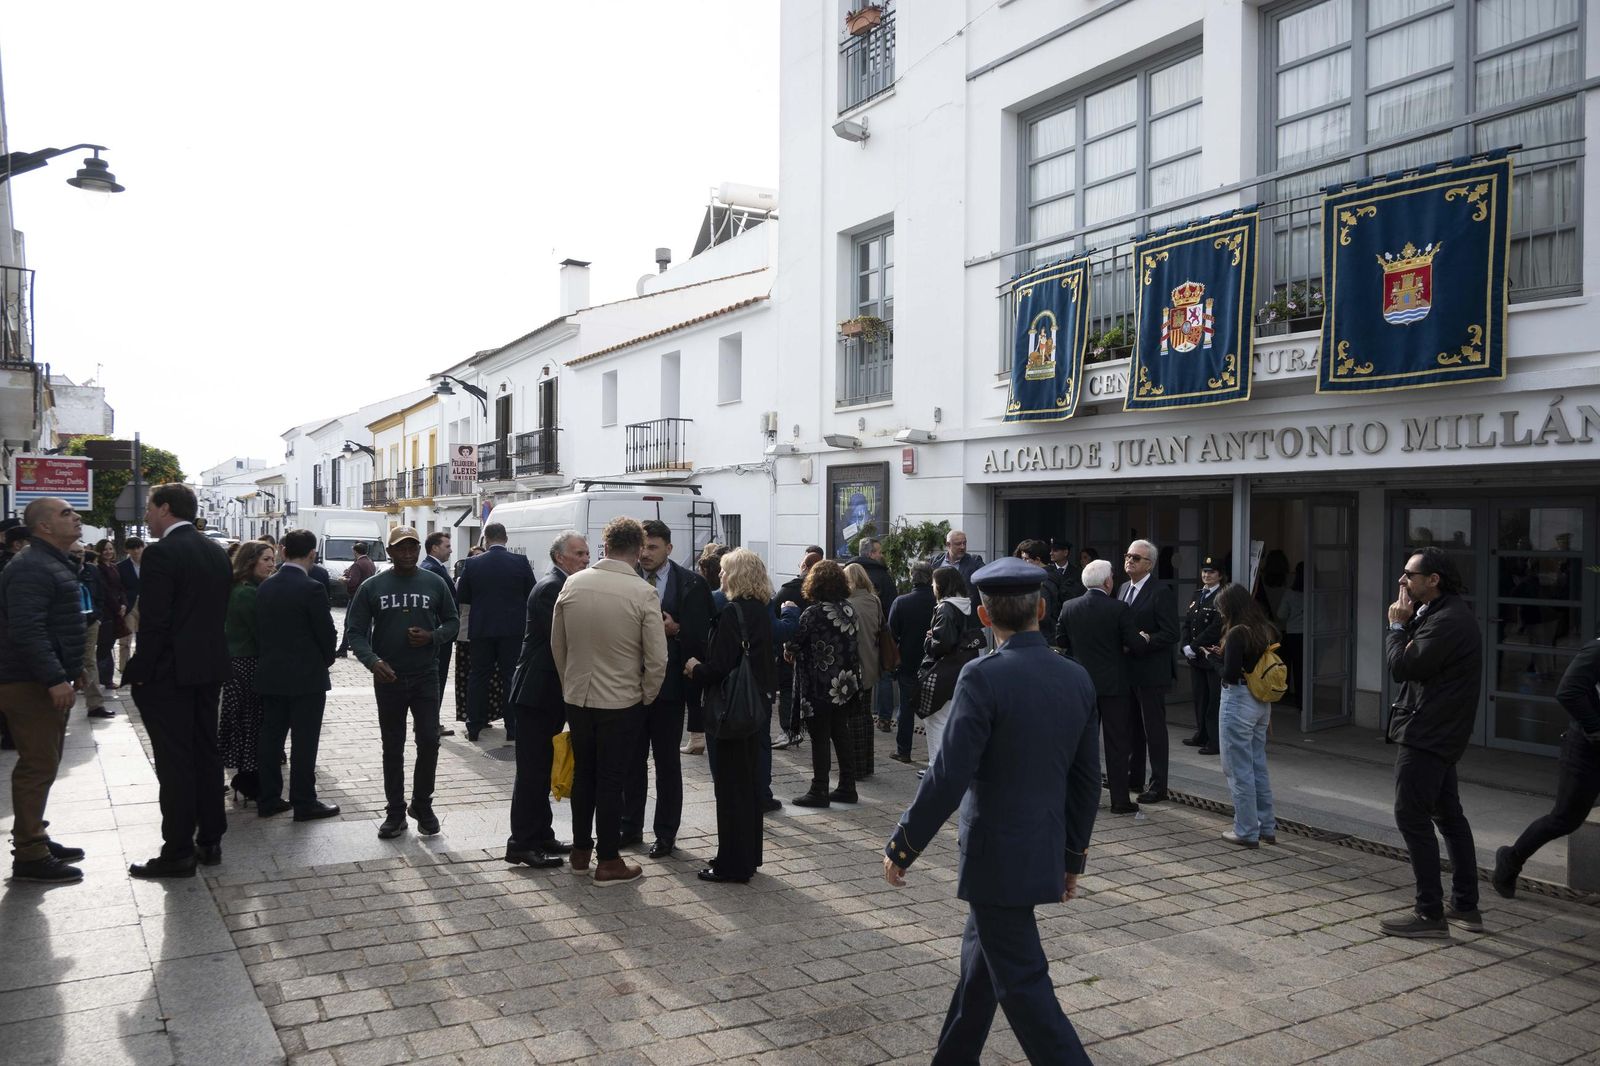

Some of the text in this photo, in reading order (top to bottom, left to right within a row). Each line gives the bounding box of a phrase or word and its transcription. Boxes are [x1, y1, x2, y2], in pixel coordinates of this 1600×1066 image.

[1089, 372, 1129, 396] CEN
[983, 394, 1600, 474] ALCALDE JUAN ANTONIO MILLÁN
[380, 593, 430, 610] ELITE
